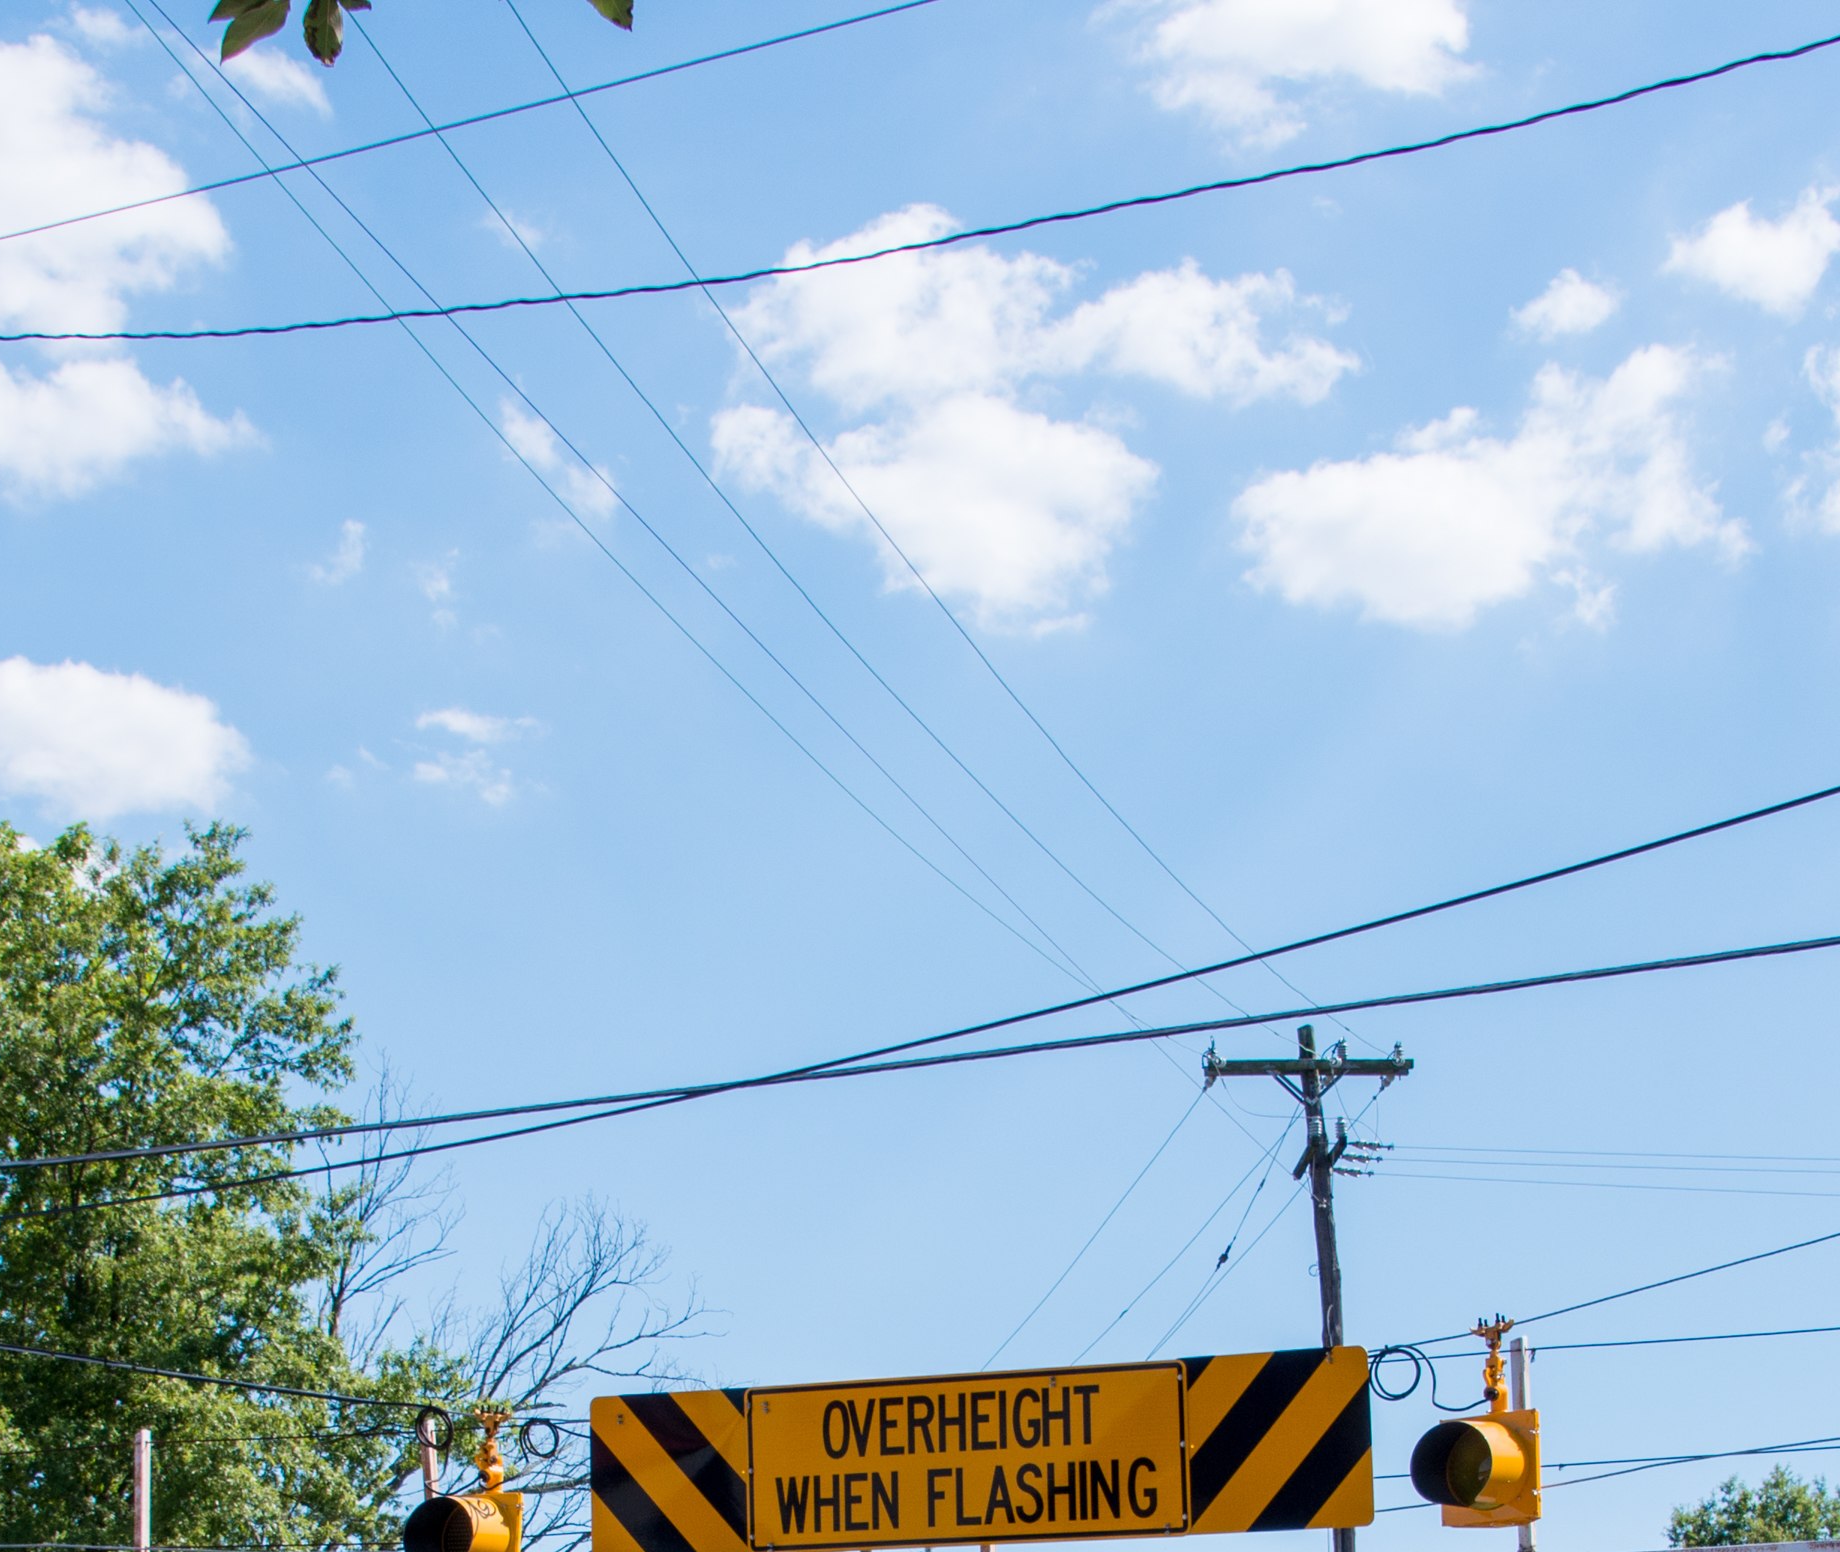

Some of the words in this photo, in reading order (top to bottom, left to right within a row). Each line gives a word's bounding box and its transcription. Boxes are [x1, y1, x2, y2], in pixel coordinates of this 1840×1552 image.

[822, 1384, 1100, 1459] OVERHEIGHT
[775, 1471, 899, 1535] WHEN
[927, 1457, 1158, 1528] FLASHING
